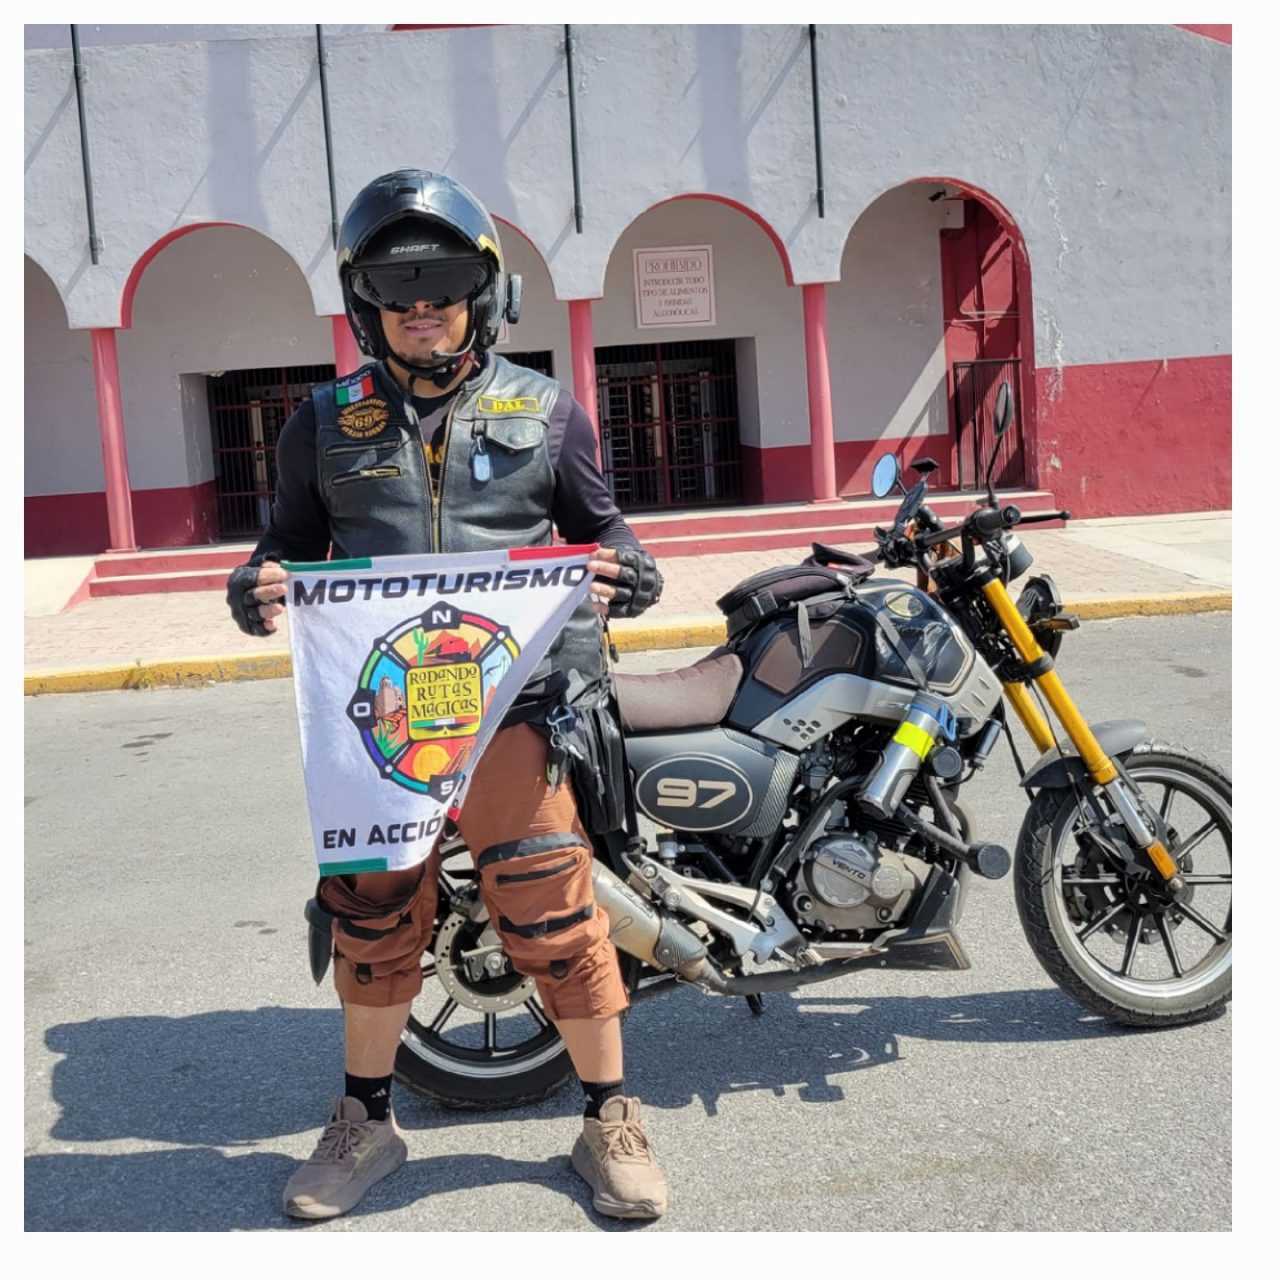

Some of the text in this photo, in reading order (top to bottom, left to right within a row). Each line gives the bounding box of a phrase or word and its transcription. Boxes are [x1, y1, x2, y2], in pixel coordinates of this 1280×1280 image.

[390, 243, 440, 255] SHAFT
[293, 564, 587, 607] MOTOTURISMO
[432, 610, 452, 624] N
[440, 780, 454, 796] S
[656, 778, 737, 809] 97
[323, 827, 356, 850] EN
[832, 858, 866, 880] VENTO
